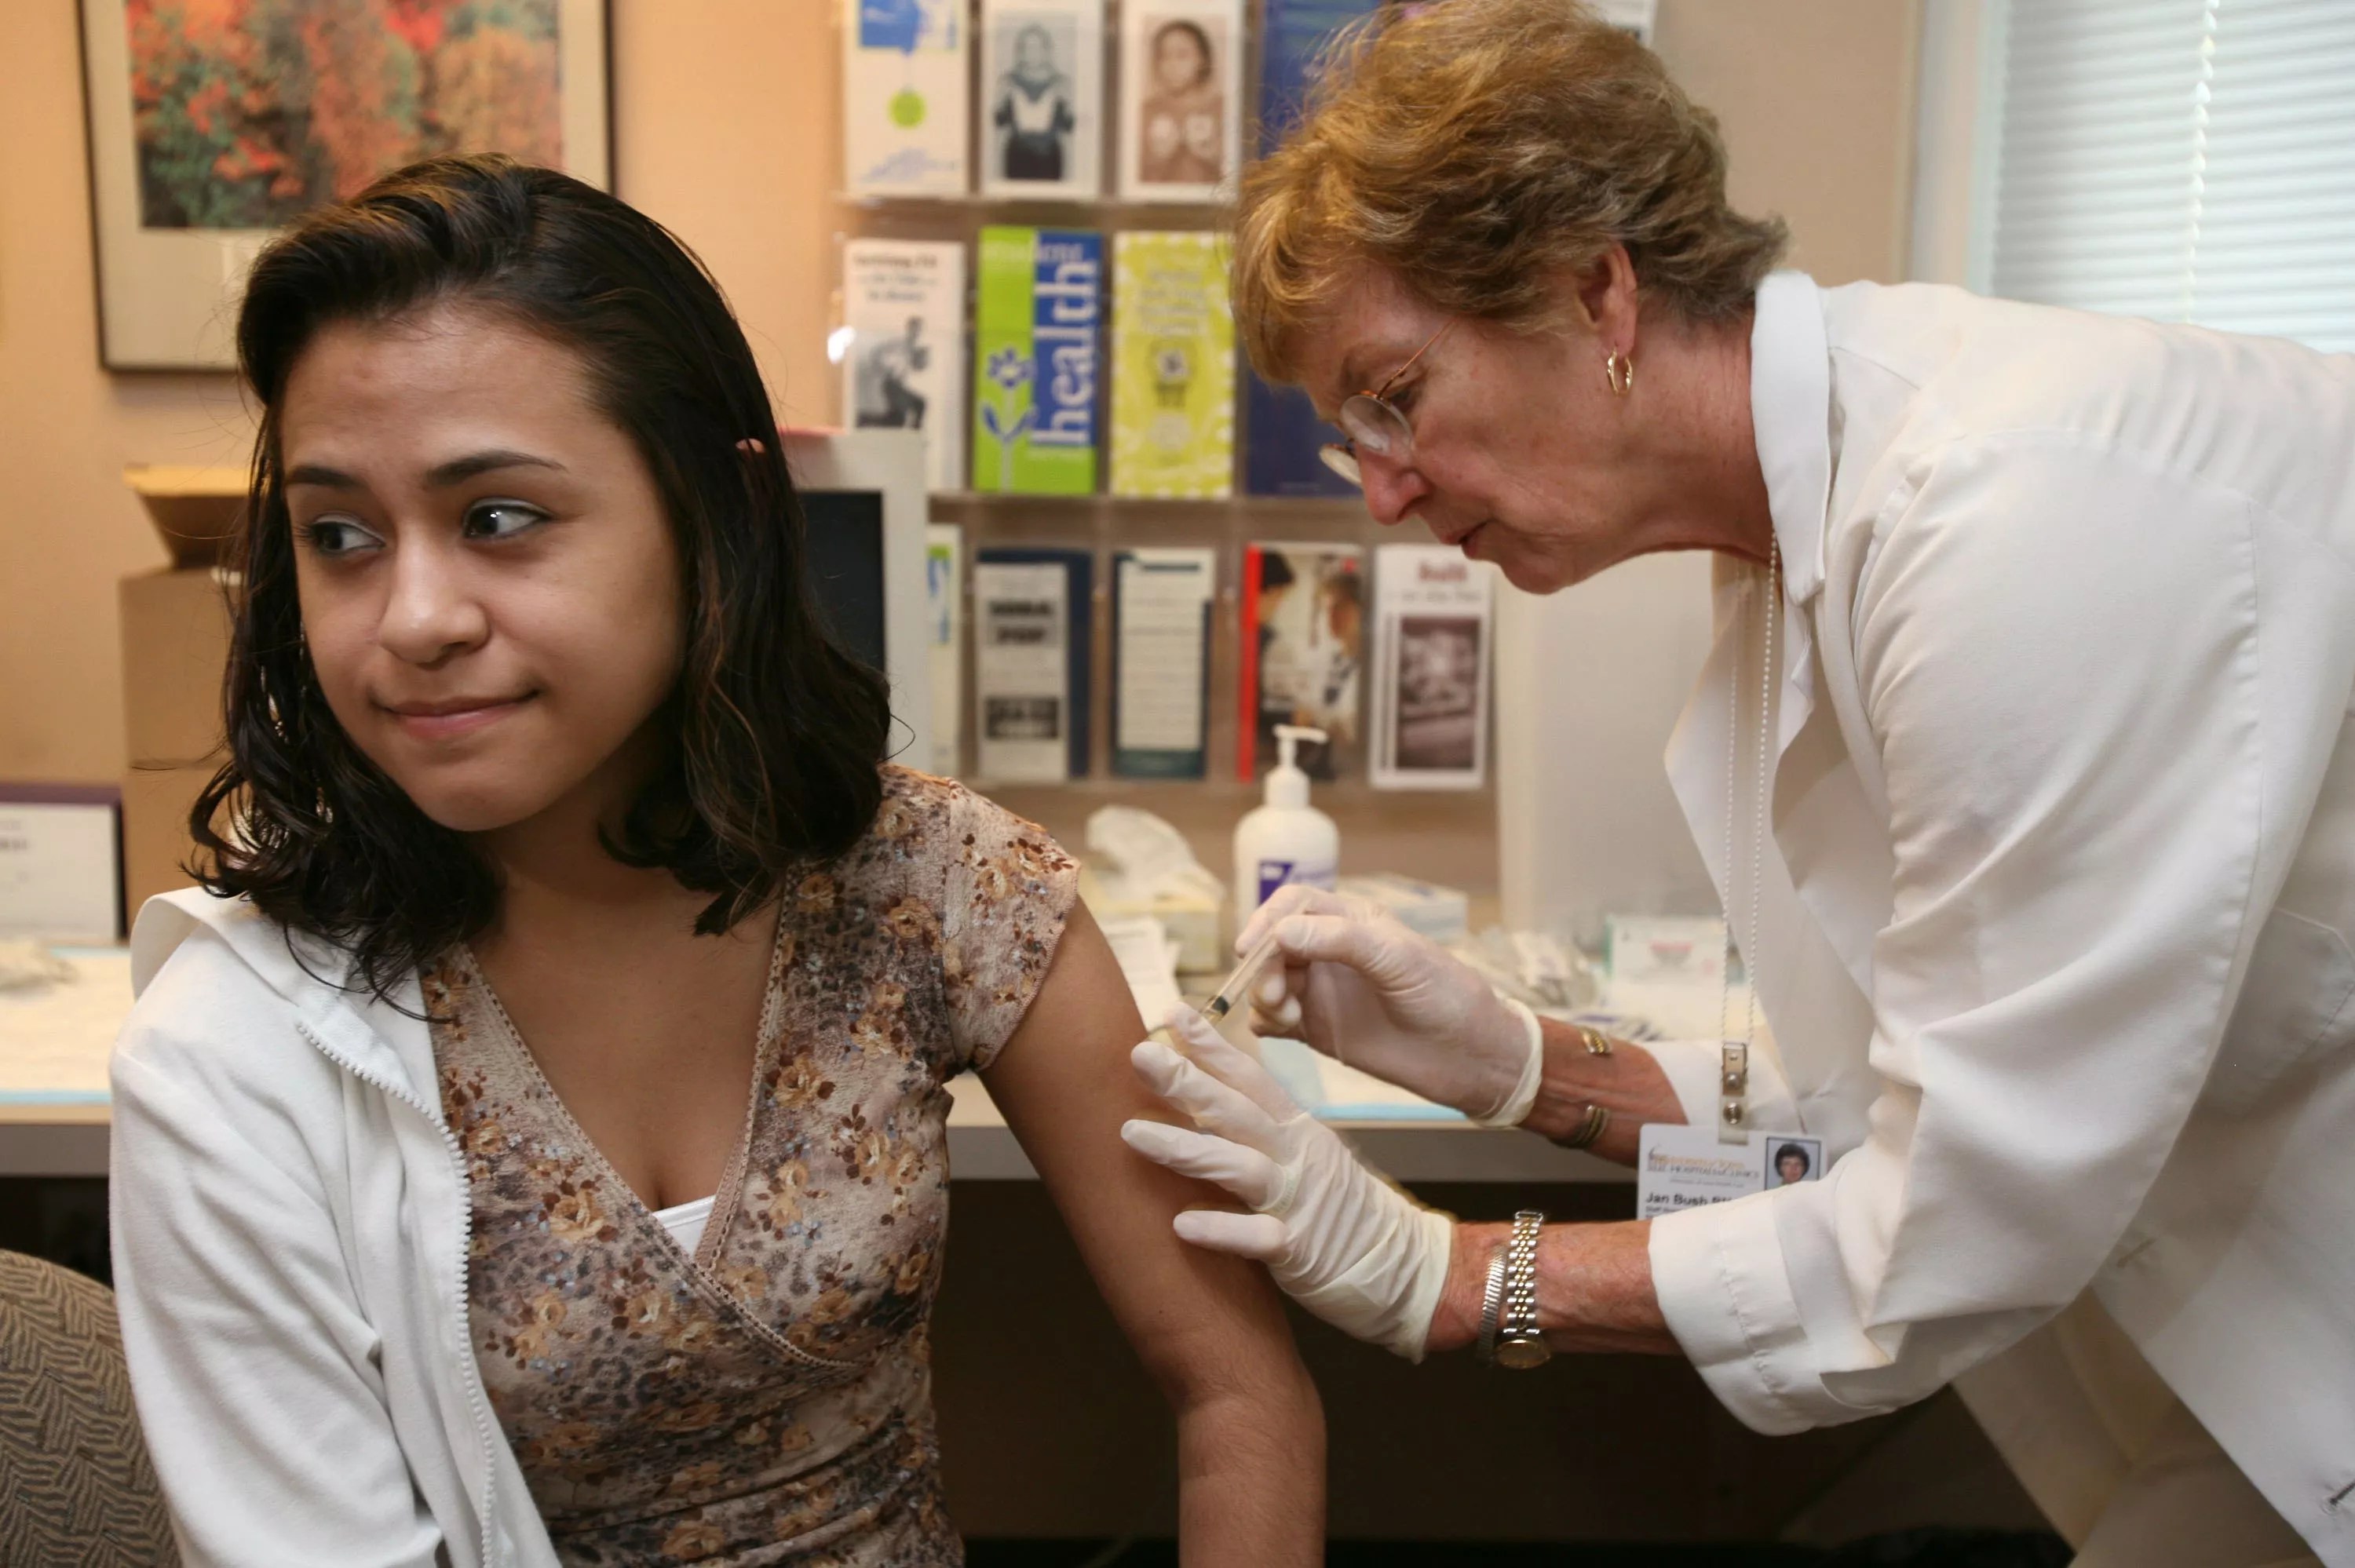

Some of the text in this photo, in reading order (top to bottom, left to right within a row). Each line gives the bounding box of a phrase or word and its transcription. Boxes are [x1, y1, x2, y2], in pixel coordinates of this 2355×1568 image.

[1032, 261, 1096, 443] health
[1645, 1191, 1669, 1203] Jan
[1674, 1193, 1707, 1206] Bush
